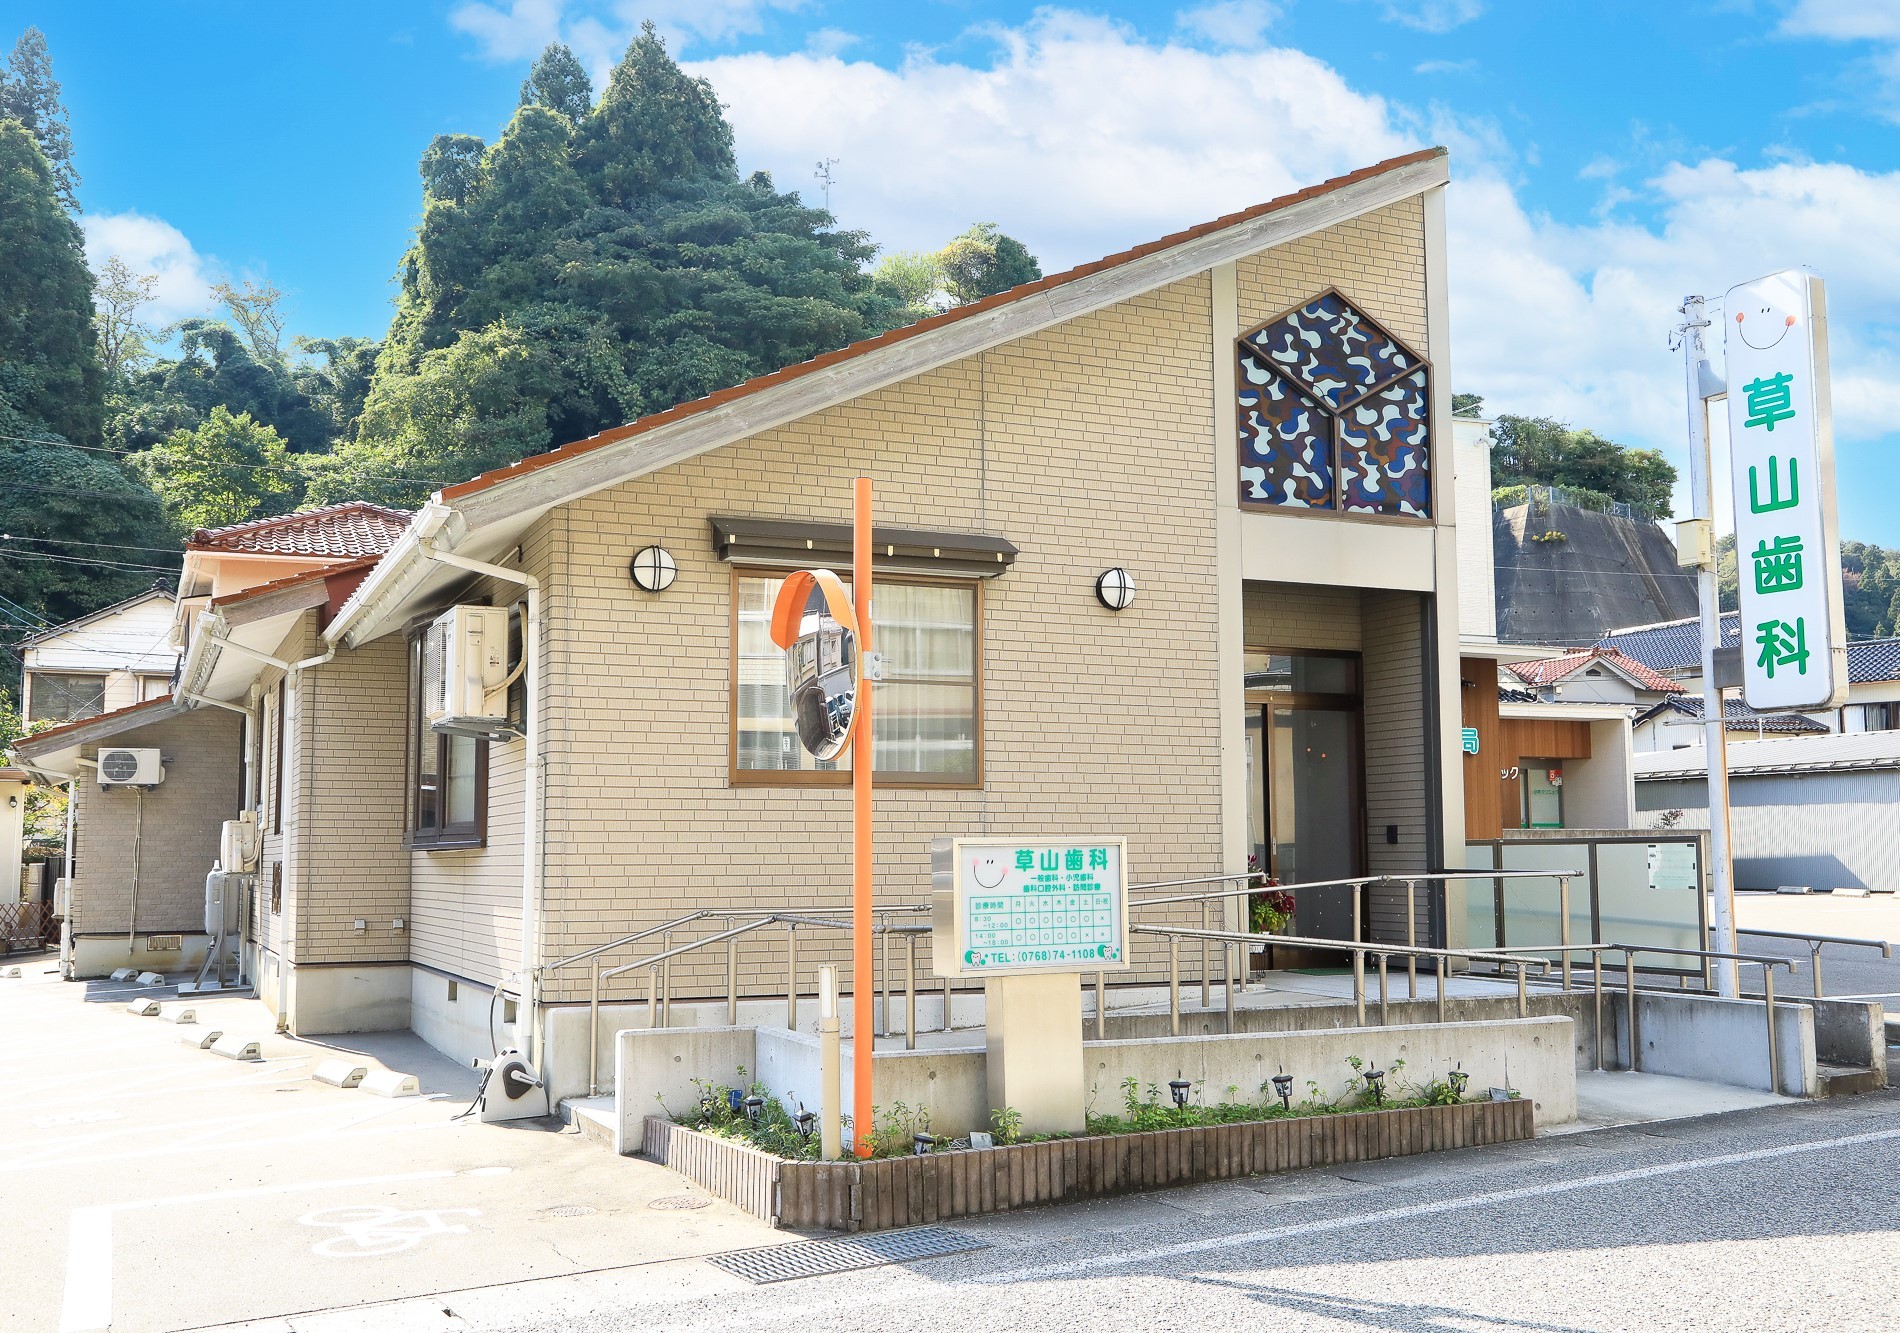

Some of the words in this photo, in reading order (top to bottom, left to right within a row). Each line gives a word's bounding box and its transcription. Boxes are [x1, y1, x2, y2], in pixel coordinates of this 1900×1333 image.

[1743, 371, 1810, 679] 草山歯科
[1015, 848, 1108, 872] 草山歯科
[1030, 873, 1094, 882] 一般歯科・小児歯科
[975, 901, 1004, 910] 診療時間
[1015, 900, 1021, 908] 月
